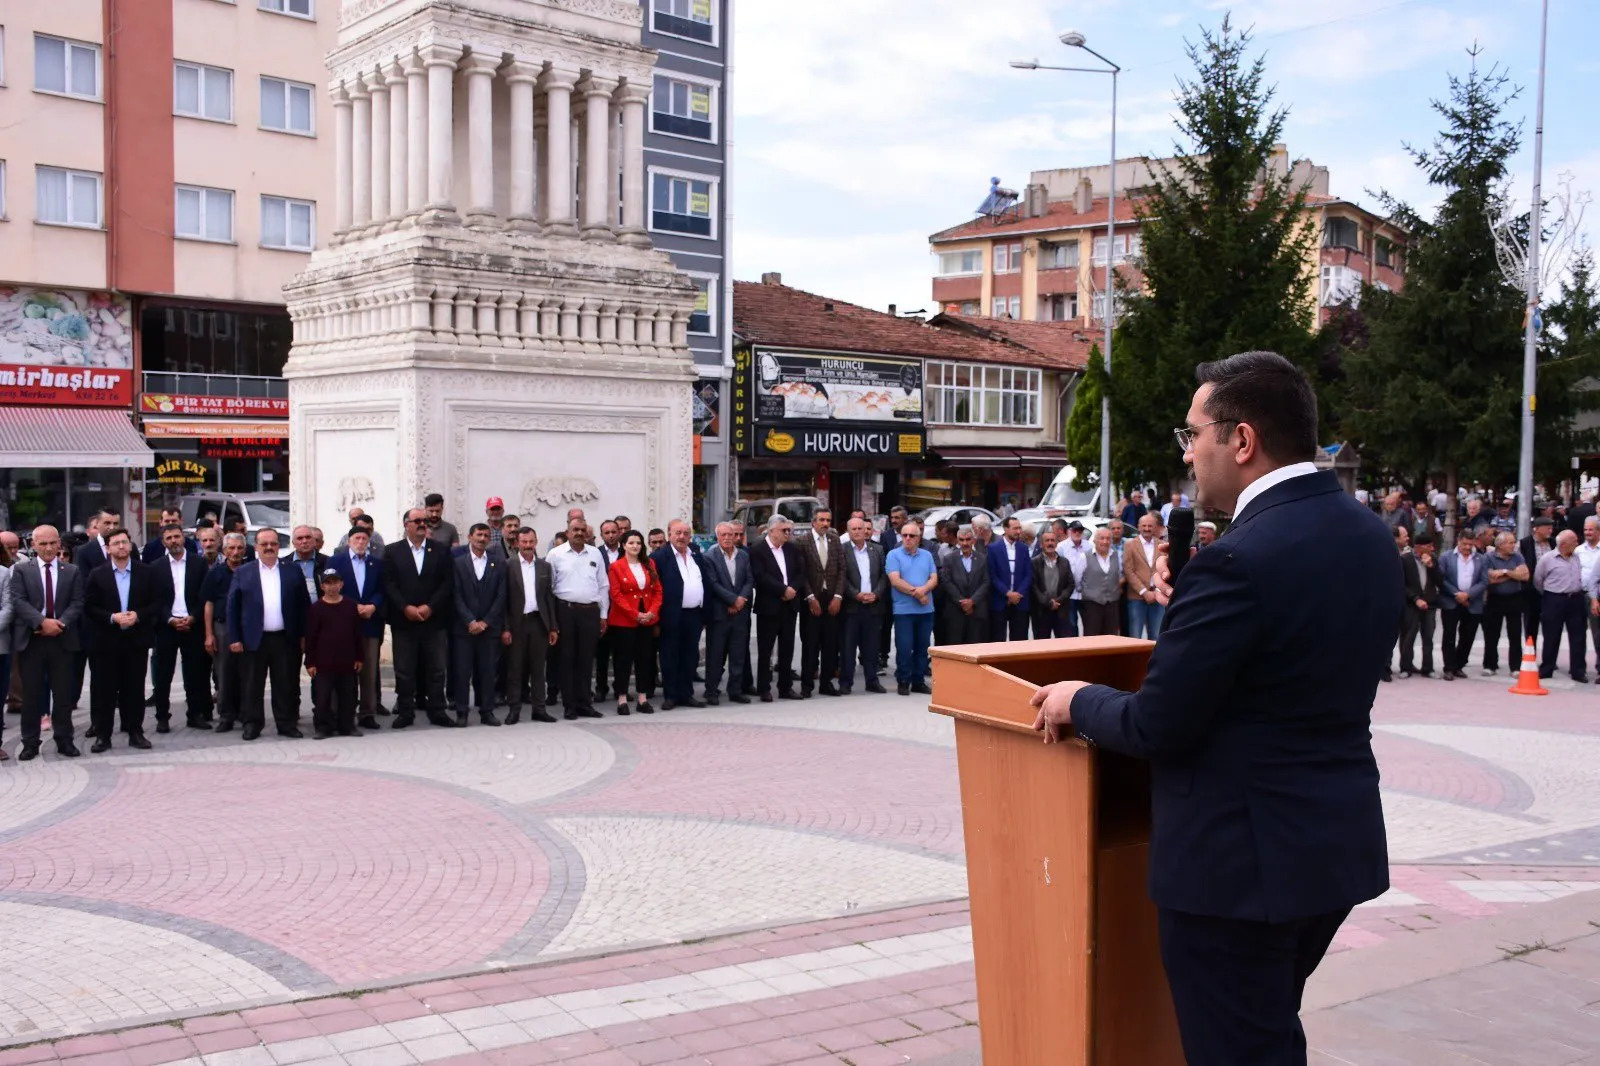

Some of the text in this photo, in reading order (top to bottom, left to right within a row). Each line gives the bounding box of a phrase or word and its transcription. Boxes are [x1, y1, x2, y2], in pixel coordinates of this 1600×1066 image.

[821, 359, 864, 370] HURUNCU
[175, 395, 198, 407] BİR
[201, 398, 225, 407] TAT
[736, 362, 744, 451] HURUNCU
[804, 433, 890, 453] HURUNCU
[156, 459, 207, 476] BİR TAT
